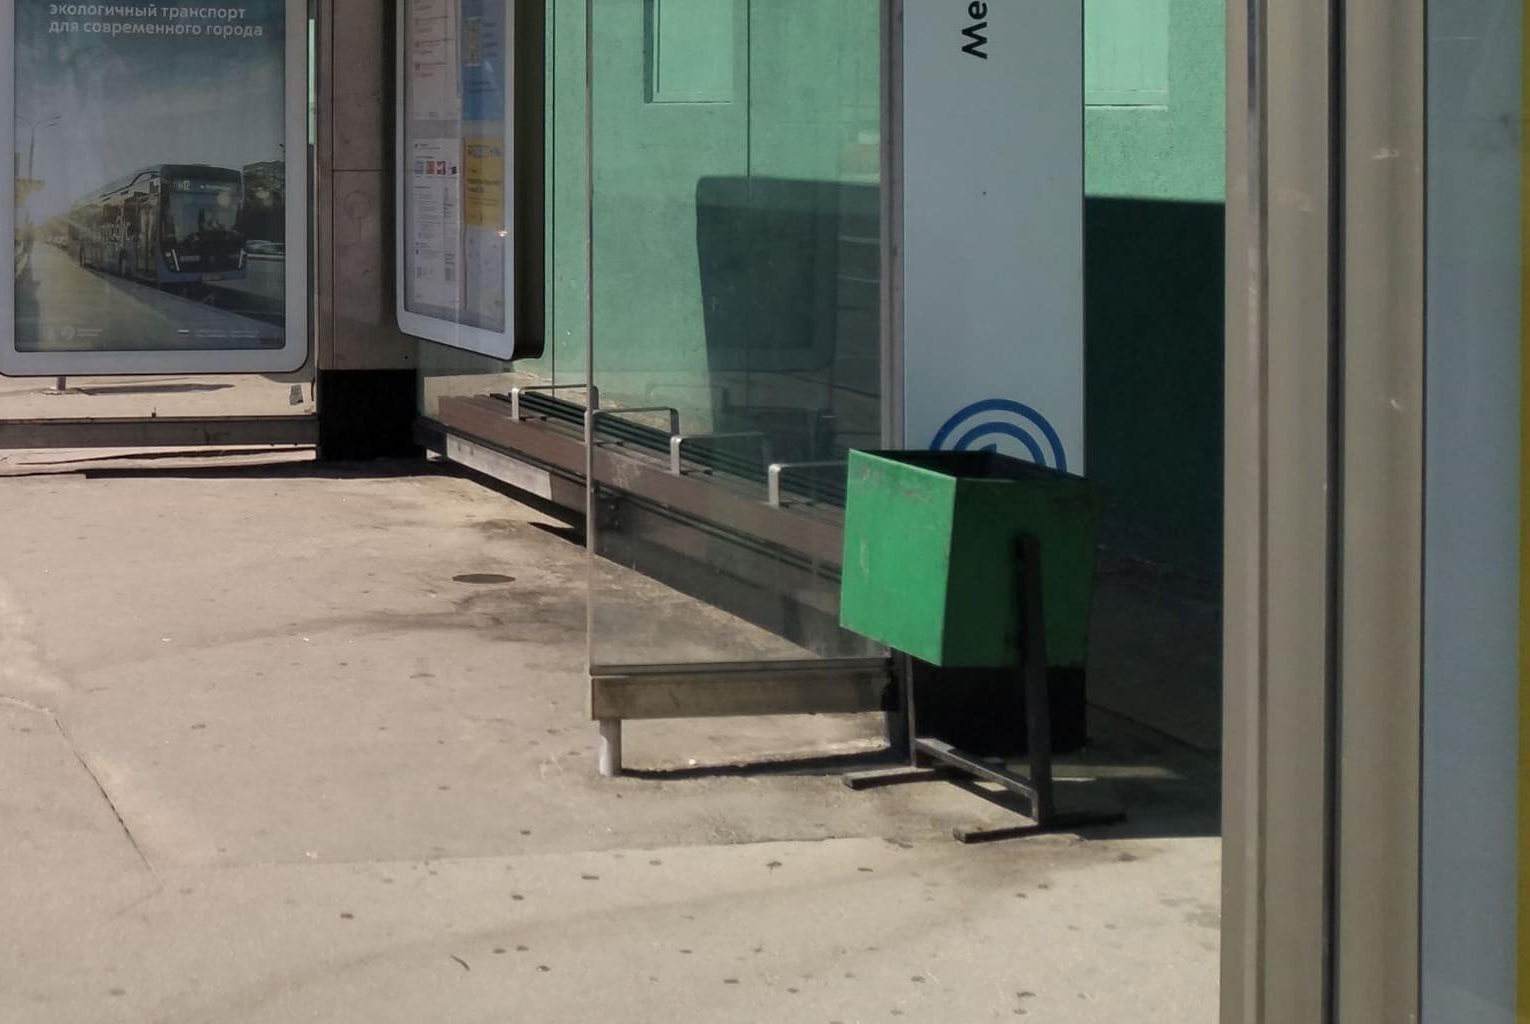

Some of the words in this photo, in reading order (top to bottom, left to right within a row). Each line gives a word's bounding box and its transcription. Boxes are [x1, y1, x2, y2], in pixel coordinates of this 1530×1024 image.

[49, 3, 158, 18] экологичный
[161, 5, 246, 22] транспорт
[48, 20, 80, 34] для
[82, 21, 202, 36] современного
[205, 24, 264, 38] города
